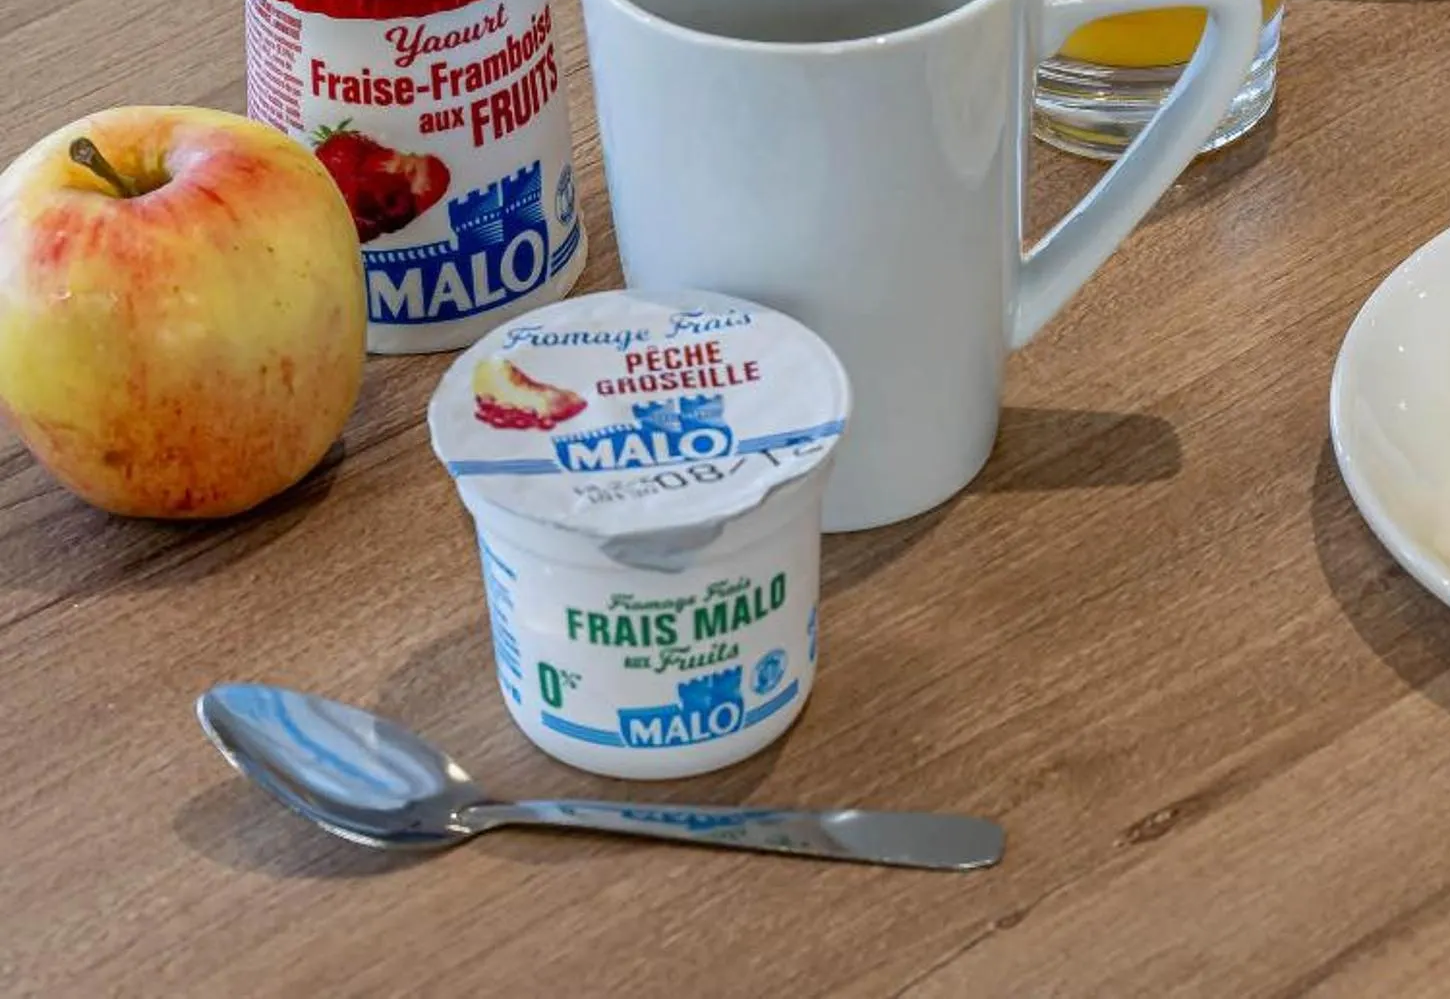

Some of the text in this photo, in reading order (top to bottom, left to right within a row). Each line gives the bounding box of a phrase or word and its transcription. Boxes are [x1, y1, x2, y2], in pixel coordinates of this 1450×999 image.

[384, 3, 508, 68] Yaourt
[418, 42, 559, 148] aux FRUITS
[368, 229, 545, 320] MALO
[502, 308, 753, 352] Fromage Frais
[596, 360, 761, 397] GROSEILLE
[624, 340, 723, 374] PÊCHE
[567, 428, 729, 472] MALO
[566, 572, 786, 647] FRAIS MALO
[654, 643, 740, 674] Fruits
[629, 702, 740, 747] MALO
